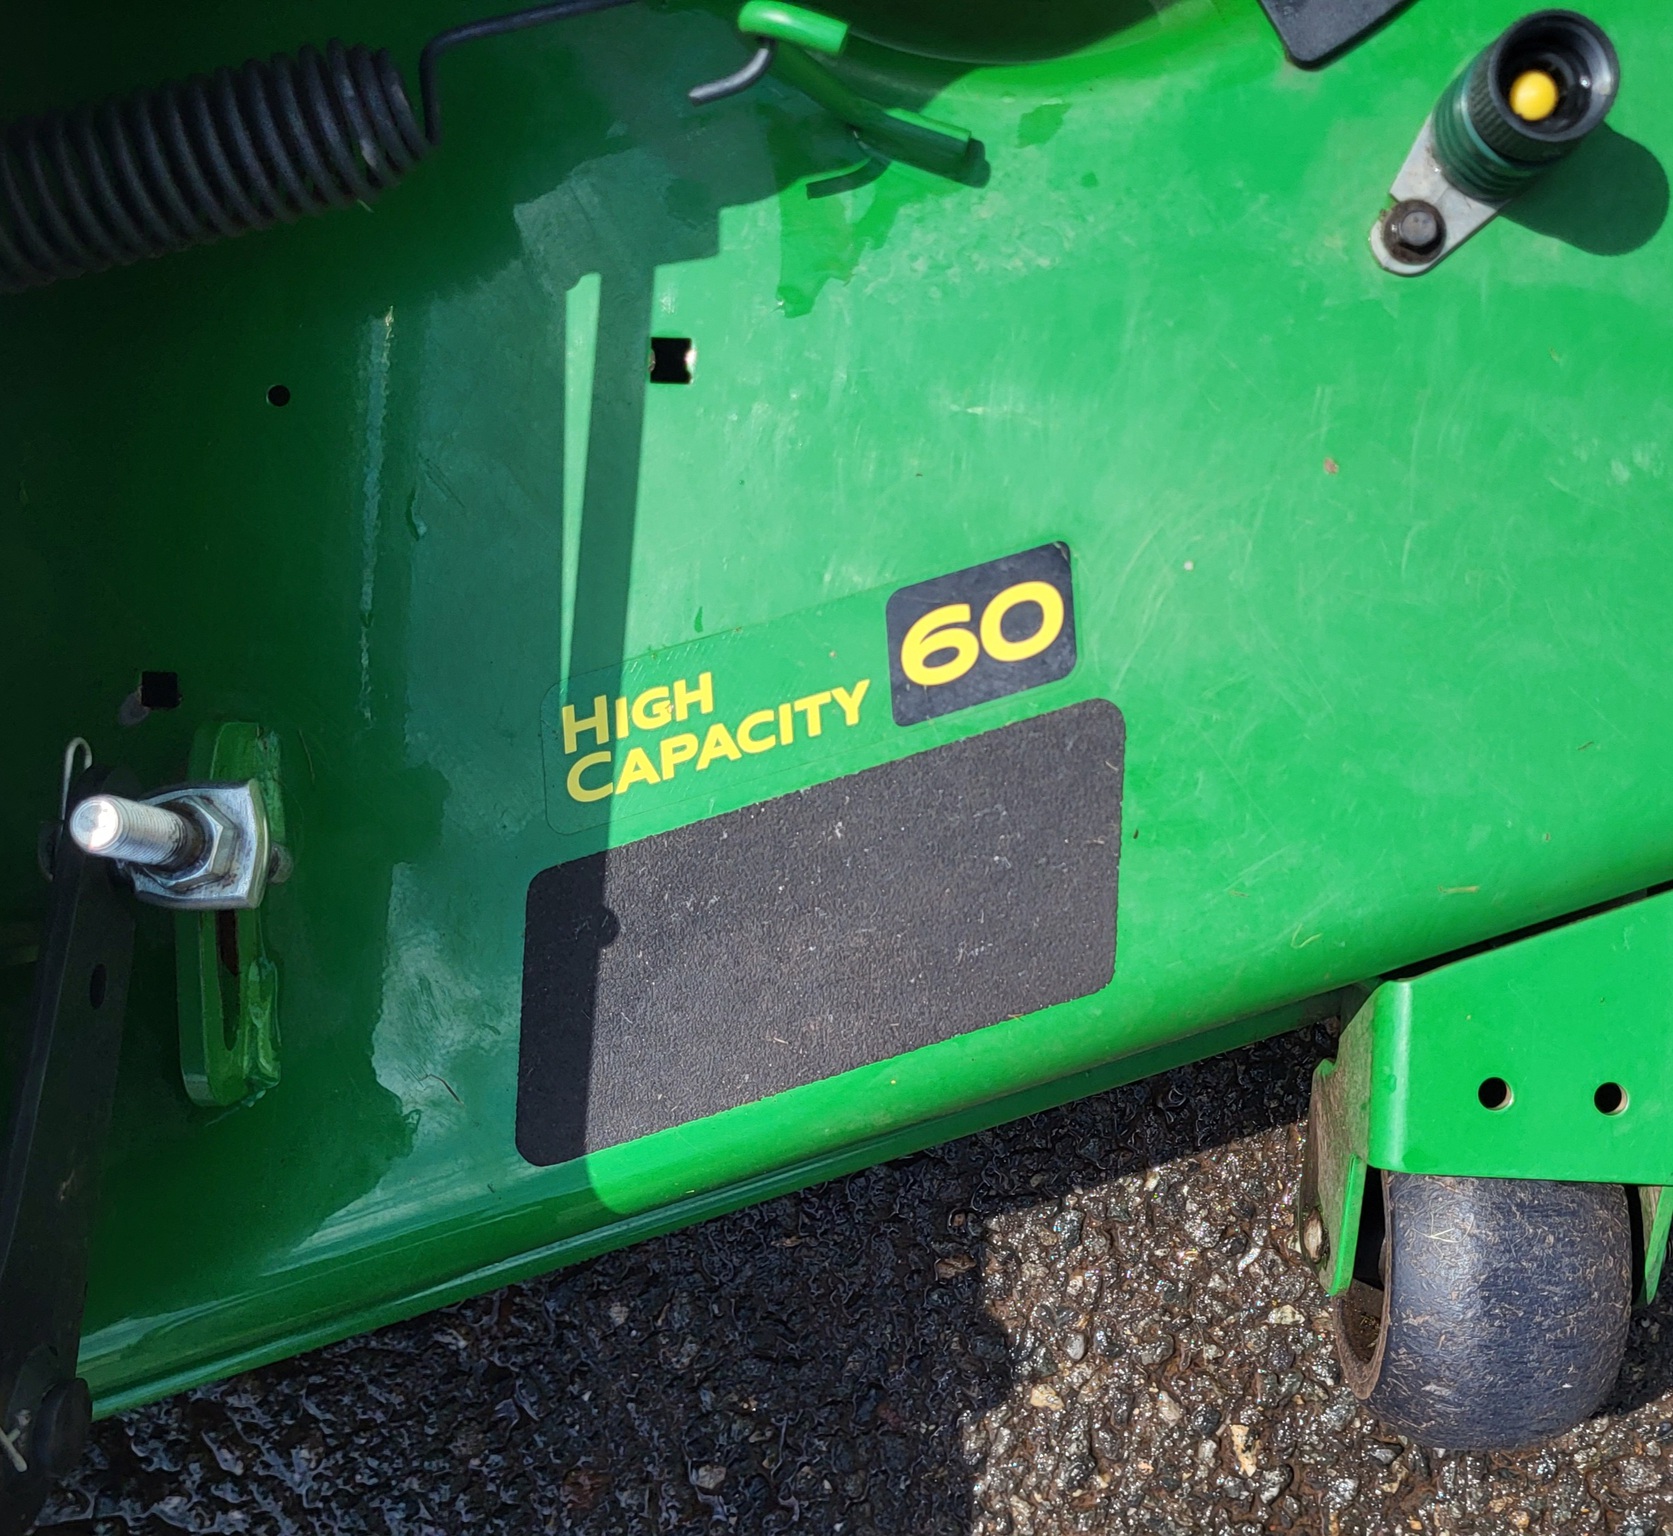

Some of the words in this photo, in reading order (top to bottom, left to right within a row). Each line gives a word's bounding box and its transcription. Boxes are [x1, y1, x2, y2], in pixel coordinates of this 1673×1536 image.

[900, 580, 1065, 687] 60
[562, 672, 714, 755] HIGH
[566, 679, 871, 803] CAPACITY
